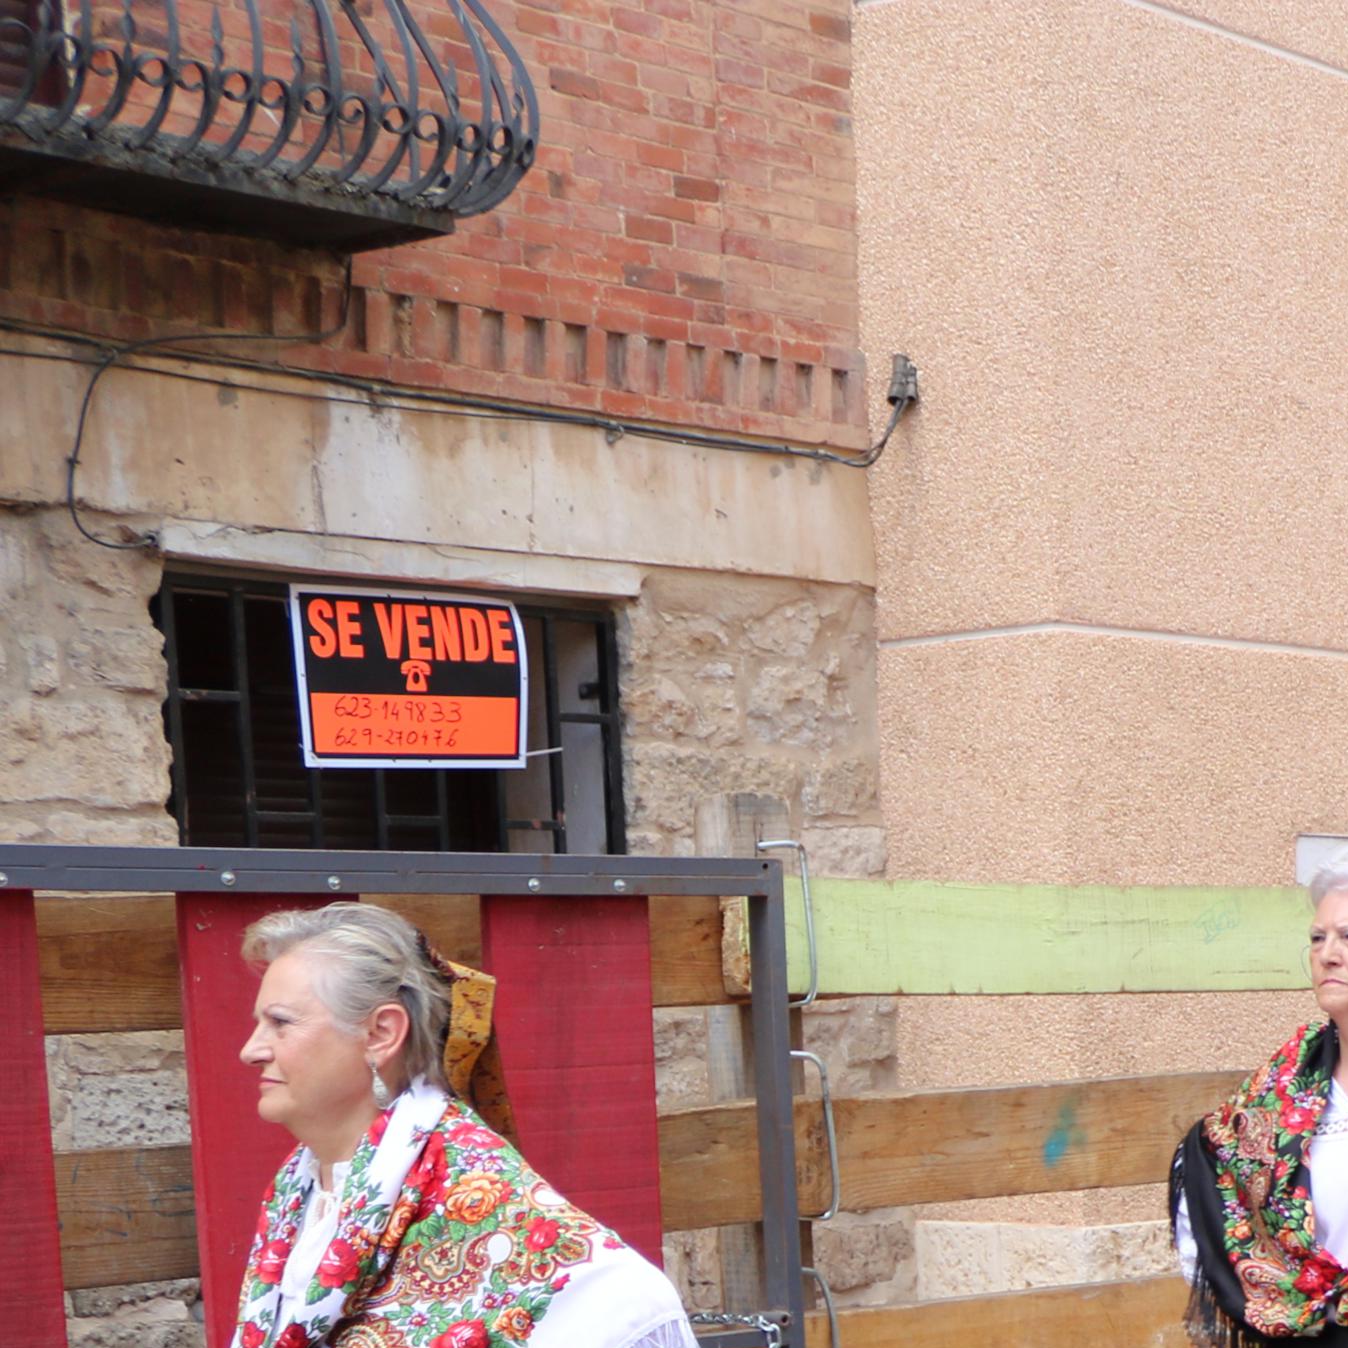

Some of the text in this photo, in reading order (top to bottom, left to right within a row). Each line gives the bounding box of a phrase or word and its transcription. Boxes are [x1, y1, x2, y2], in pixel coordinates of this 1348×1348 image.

[307, 598, 516, 664] SE VENDE
[333, 695, 462, 723] 623-149833
